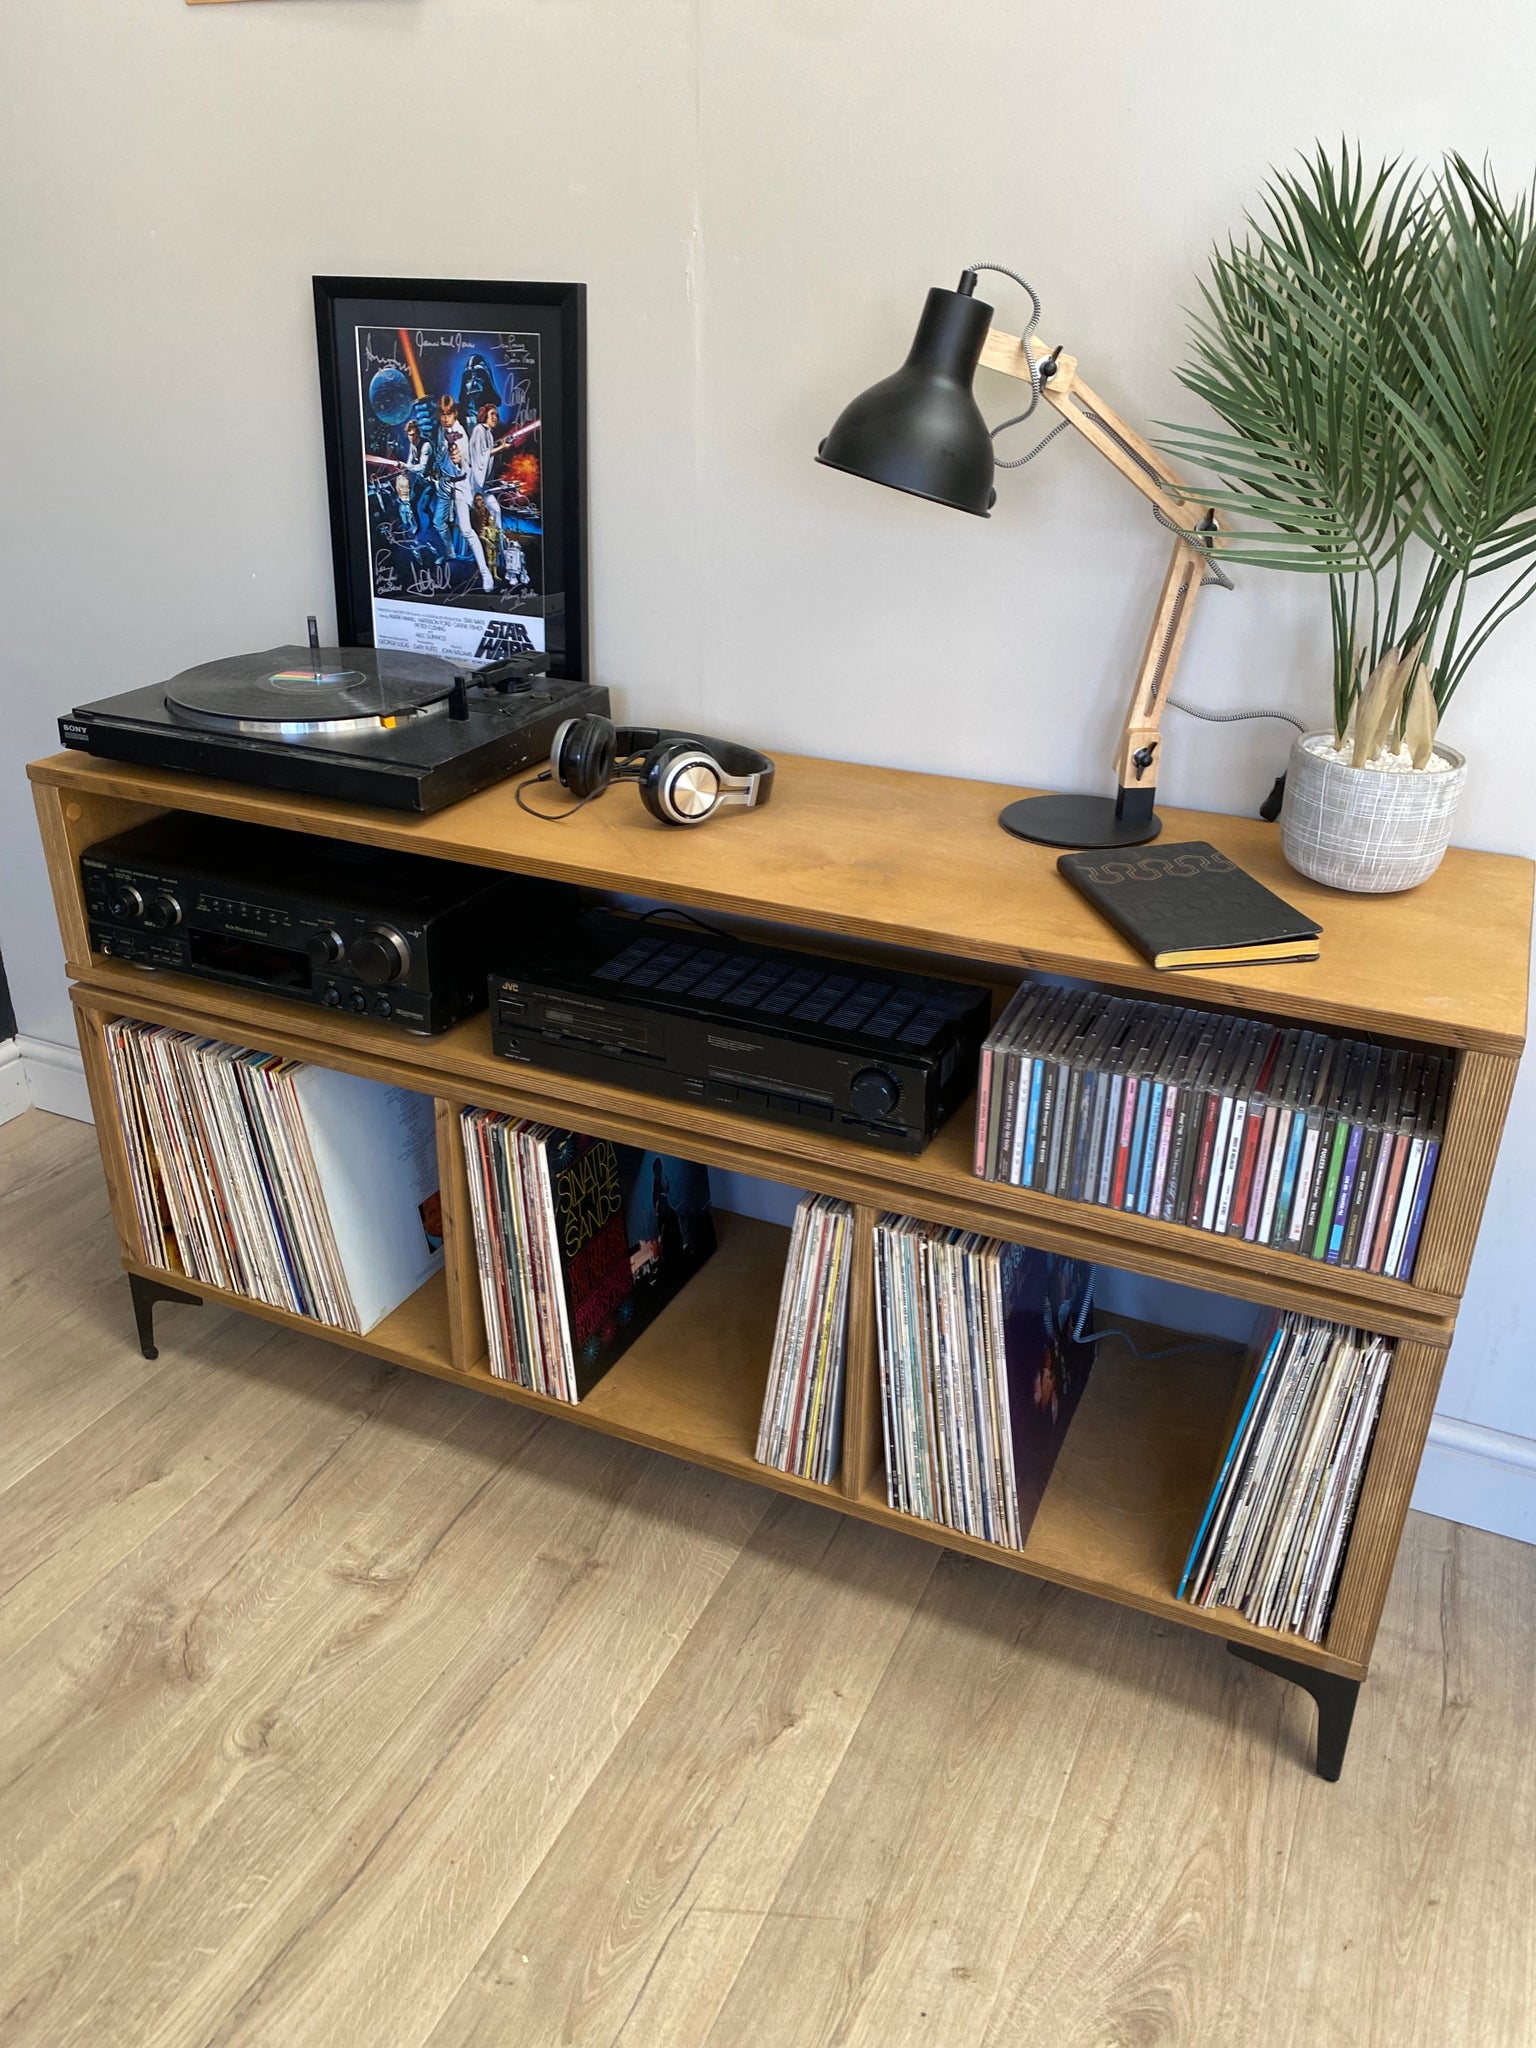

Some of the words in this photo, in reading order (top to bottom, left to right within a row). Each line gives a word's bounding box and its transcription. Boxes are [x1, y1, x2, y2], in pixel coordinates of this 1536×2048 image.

[484, 620, 532, 643] STAR
[63, 724, 87, 734] SONY
[502, 982, 519, 993] JVC
[1318, 1147, 1328, 1169] FUGEES
[557, 1140, 618, 1213] SINATRA
[565, 1196, 586, 1229] AT
[586, 1169, 621, 1205] THE
[566, 1181, 622, 1257] SANDS
